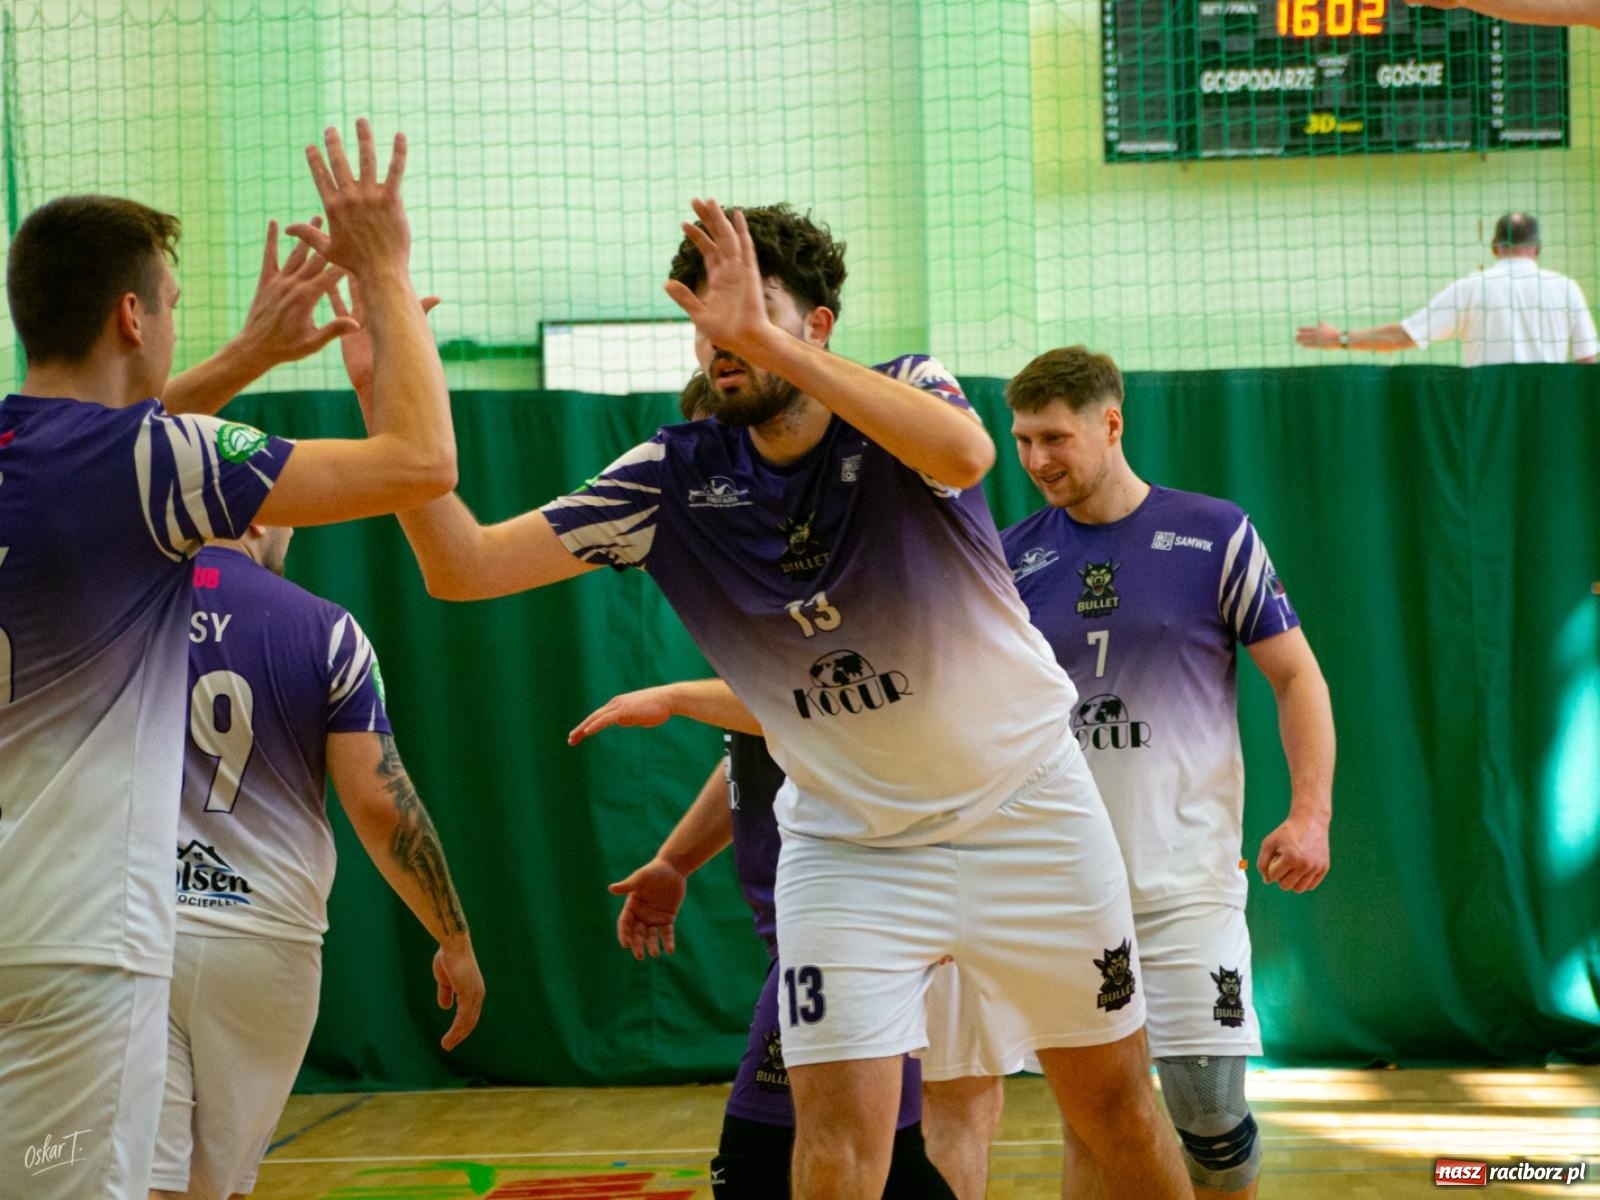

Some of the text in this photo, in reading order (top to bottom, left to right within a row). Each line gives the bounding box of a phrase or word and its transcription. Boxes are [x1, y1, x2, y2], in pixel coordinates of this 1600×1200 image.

[1200, 67, 1317, 93] GOSPODARZE
[1377, 58, 1444, 88] GOŚCIE
[1174, 536, 1214, 552] SAMWIK
[783, 591, 842, 639] 13
[1077, 597, 1120, 612] BULLET
[189, 611, 232, 643] SY
[1087, 630, 1109, 678] 7
[793, 671, 914, 720] KOCUR
[190, 669, 255, 813] 9
[784, 964, 827, 1026] 13
[1100, 980, 1135, 1005] BULLET
